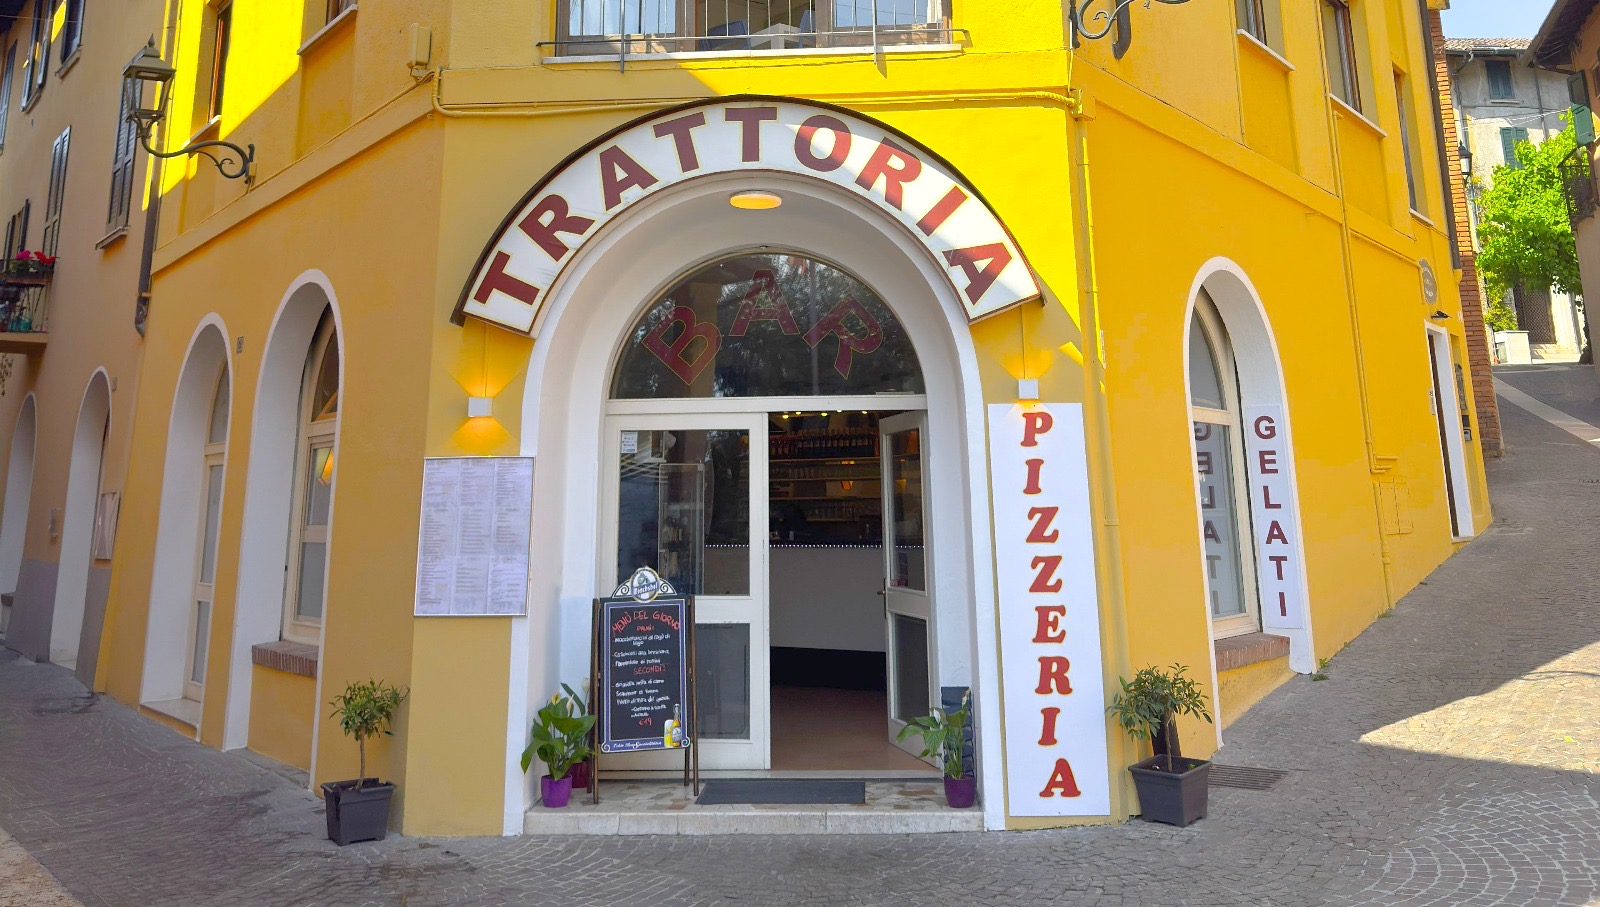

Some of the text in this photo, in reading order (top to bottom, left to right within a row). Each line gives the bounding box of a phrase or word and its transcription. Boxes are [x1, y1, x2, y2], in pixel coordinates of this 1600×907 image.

[474, 107, 1013, 307] TRATTORIA
[641, 268, 884, 386] BAR
[1019, 411, 1081, 798] PIZZERIA
[1253, 415, 1289, 617] GELATI
[633, 610, 649, 620] DEL
[652, 611, 680, 630] GIORNO
